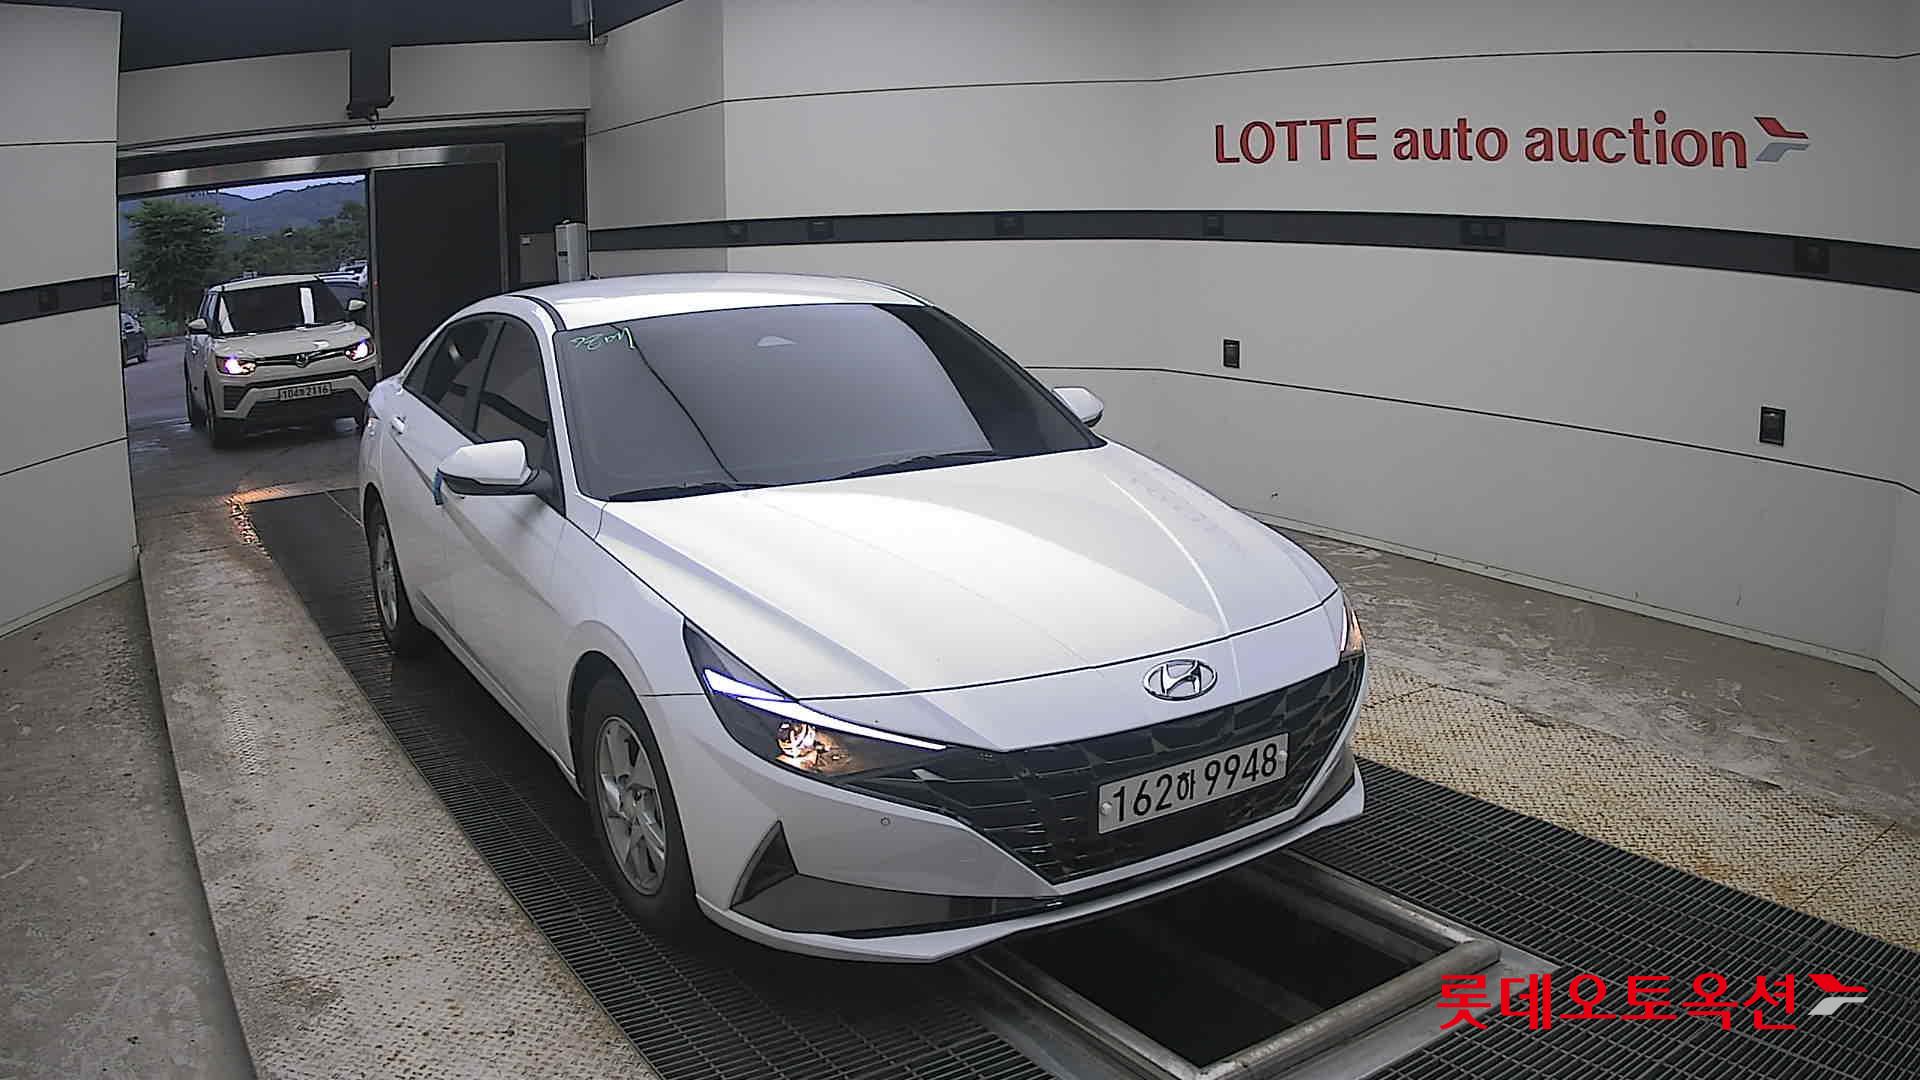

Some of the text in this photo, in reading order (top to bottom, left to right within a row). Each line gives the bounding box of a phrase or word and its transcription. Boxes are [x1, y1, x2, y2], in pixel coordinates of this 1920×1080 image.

[1215, 110, 1749, 169] LOTTE auto auction
[1113, 743, 1278, 822] 162하 9948
